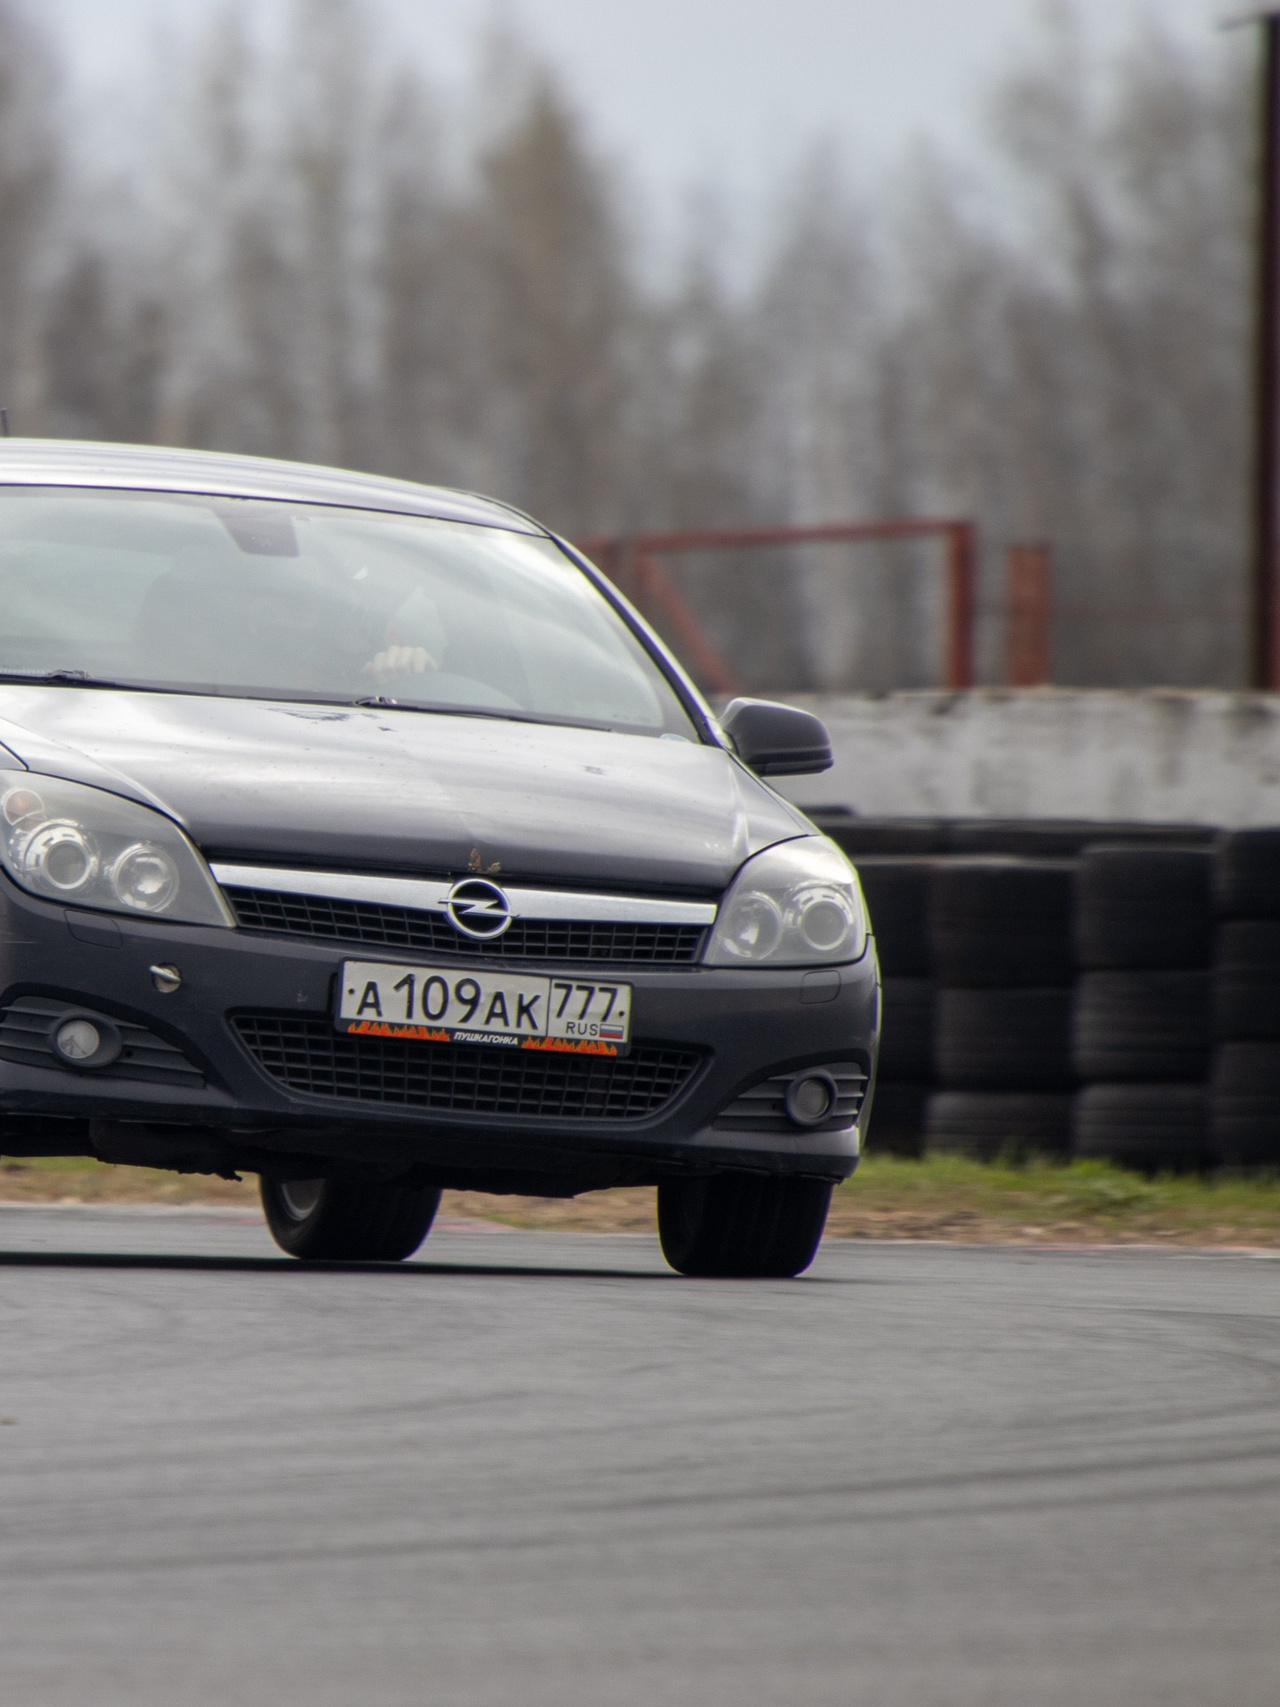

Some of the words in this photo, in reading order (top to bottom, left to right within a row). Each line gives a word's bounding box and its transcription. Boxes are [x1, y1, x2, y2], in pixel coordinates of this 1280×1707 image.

[554, 982, 618, 1022] 777
[566, 1021, 598, 1036] RUS
[453, 1031, 519, 1045] ПУШКАГОНКА
